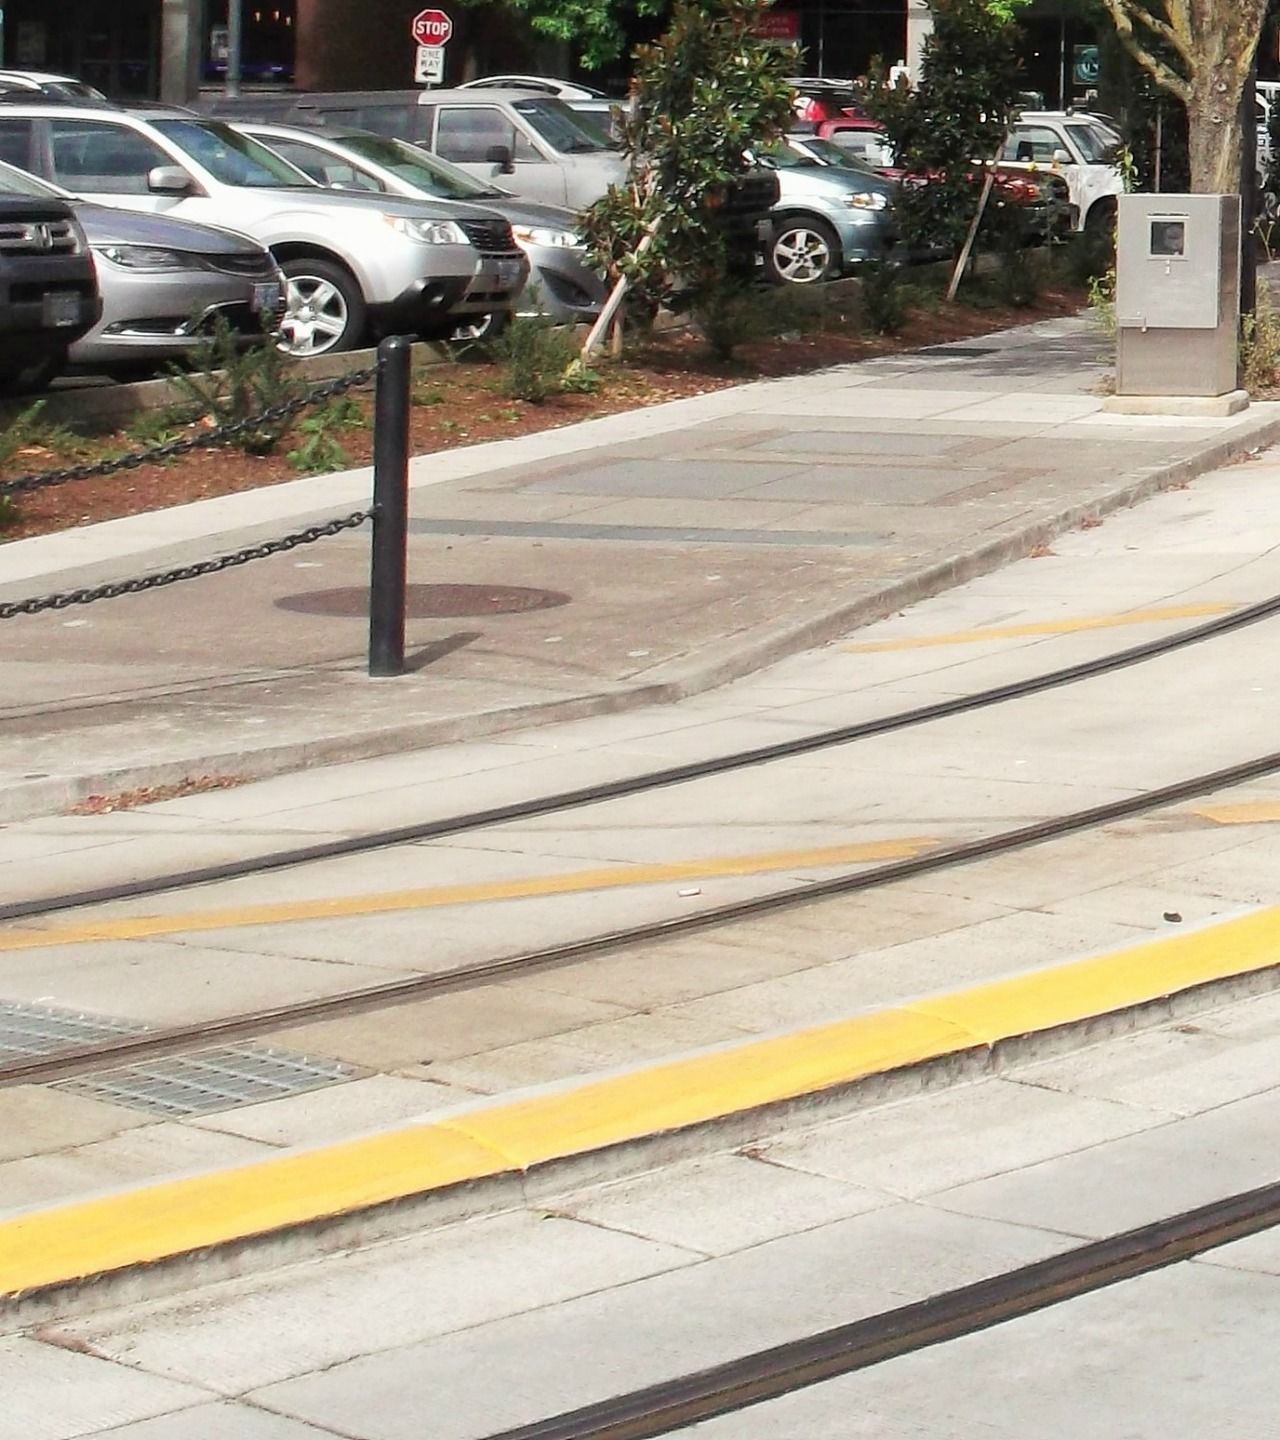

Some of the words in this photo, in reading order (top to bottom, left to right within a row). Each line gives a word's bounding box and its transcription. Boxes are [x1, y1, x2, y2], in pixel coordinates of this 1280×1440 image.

[416, 21, 449, 36] STOP
[422, 50, 441, 58] ONE
[421, 60, 440, 68] WAY
